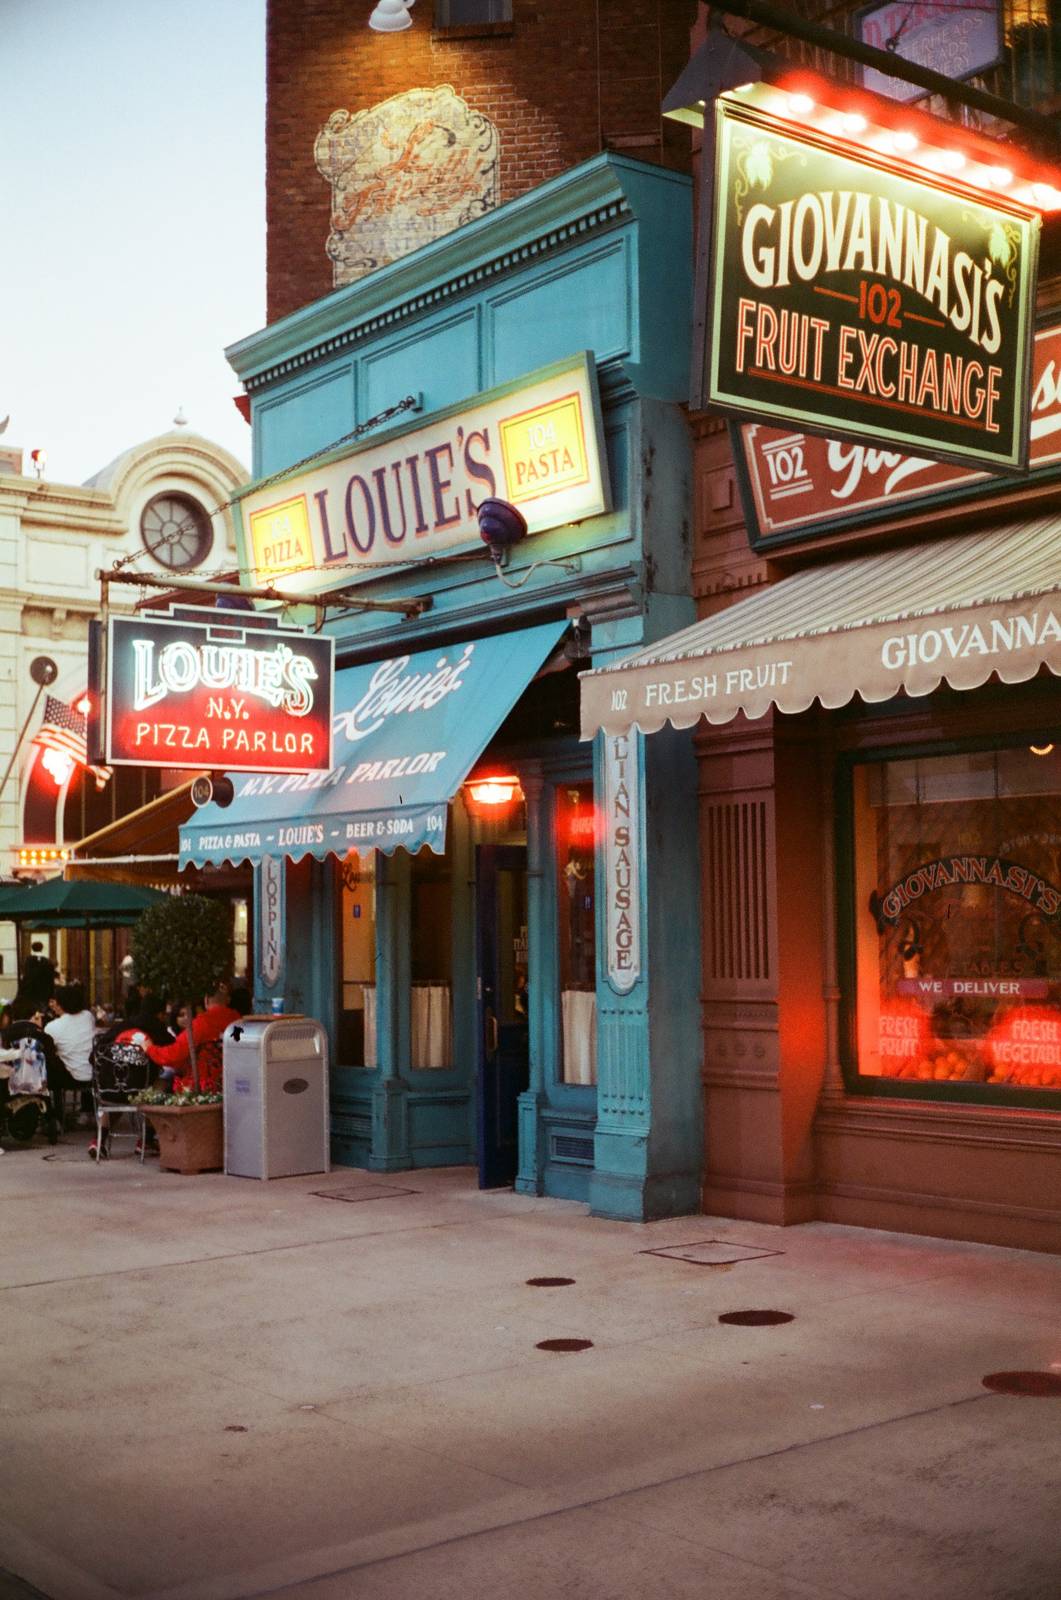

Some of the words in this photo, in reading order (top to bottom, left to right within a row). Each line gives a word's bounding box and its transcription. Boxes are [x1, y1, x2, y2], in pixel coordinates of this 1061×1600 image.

[742, 191, 1004, 354] GIOVANNASI'S
[858, 280, 902, 328] 102
[736, 298, 829, 380] FRUIT
[837, 326, 1003, 433] EXCHANGE
[515, 446, 575, 485] PASTA
[766, 446, 808, 484] 102
[314, 425, 497, 564] LOUIE'S
[264, 537, 304, 567] PIZZA
[881, 611, 1061, 670] GIOVANNA
[132, 638, 319, 717] LOUIE'S
[611, 689, 628, 711] 102
[645, 674, 718, 706] FRESH
[726, 661, 793, 694] FRUIT
[207, 697, 250, 720] N.Y.
[135, 722, 210, 749] PIZZA
[221, 728, 314, 754] PARLOR
[278, 765, 346, 793] PIZZA
[346, 752, 447, 784] PARLOR
[233, 832, 261, 848] PASTA
[279, 824, 325, 847] LOUIE'S
[346, 820, 375, 839] BEER
[386, 818, 414, 835] SODA
[426, 815, 443, 832] 104
[614, 826, 633, 970] SAUSAGE
[882, 857, 1061, 918] GIOVANNASI'S
[918, 981, 942, 994] WE
[953, 981, 1021, 994] DELIVER
[880, 1015, 919, 1036] FRESH
[1012, 1019, 1059, 1042] FRESH
